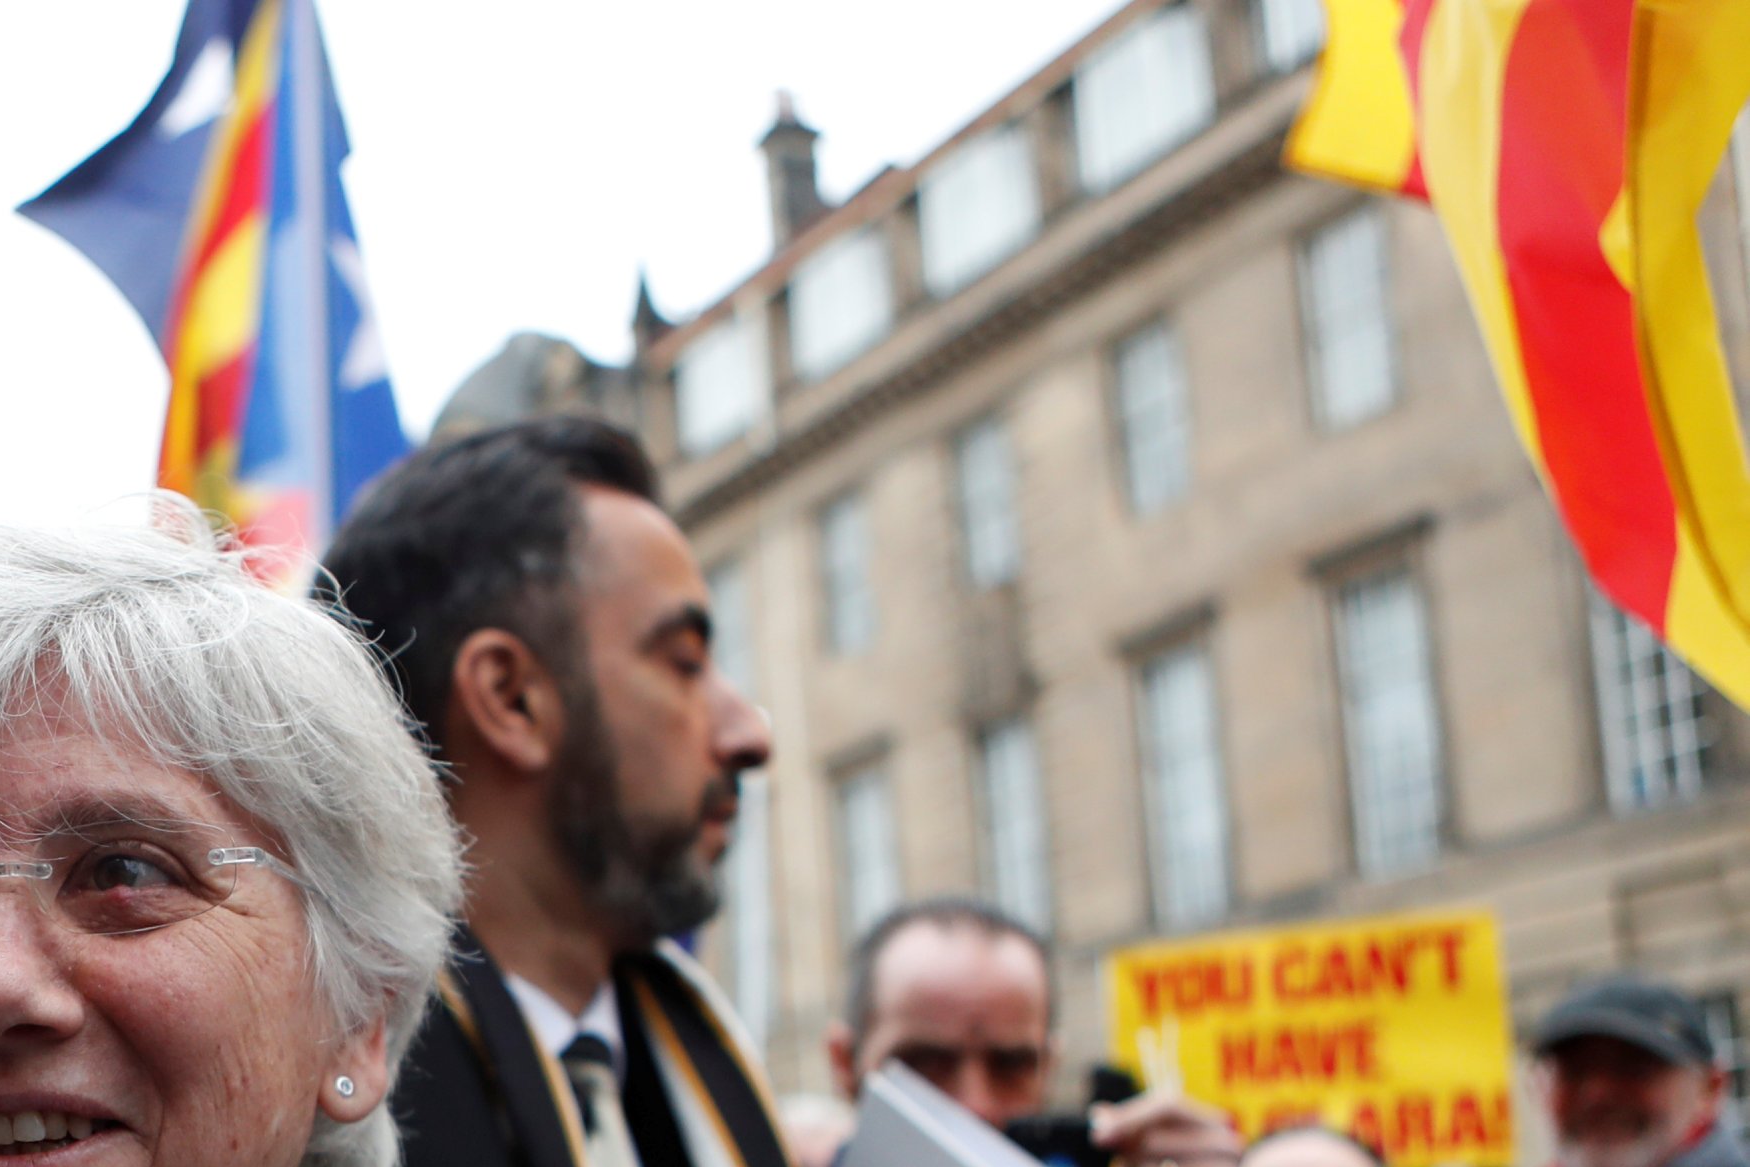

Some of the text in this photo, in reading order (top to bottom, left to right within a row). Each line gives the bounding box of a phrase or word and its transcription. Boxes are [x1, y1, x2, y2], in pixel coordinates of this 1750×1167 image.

[1133, 923, 1465, 1018] YOU CAN'T
[1218, 1016, 1377, 1086] HAVE
